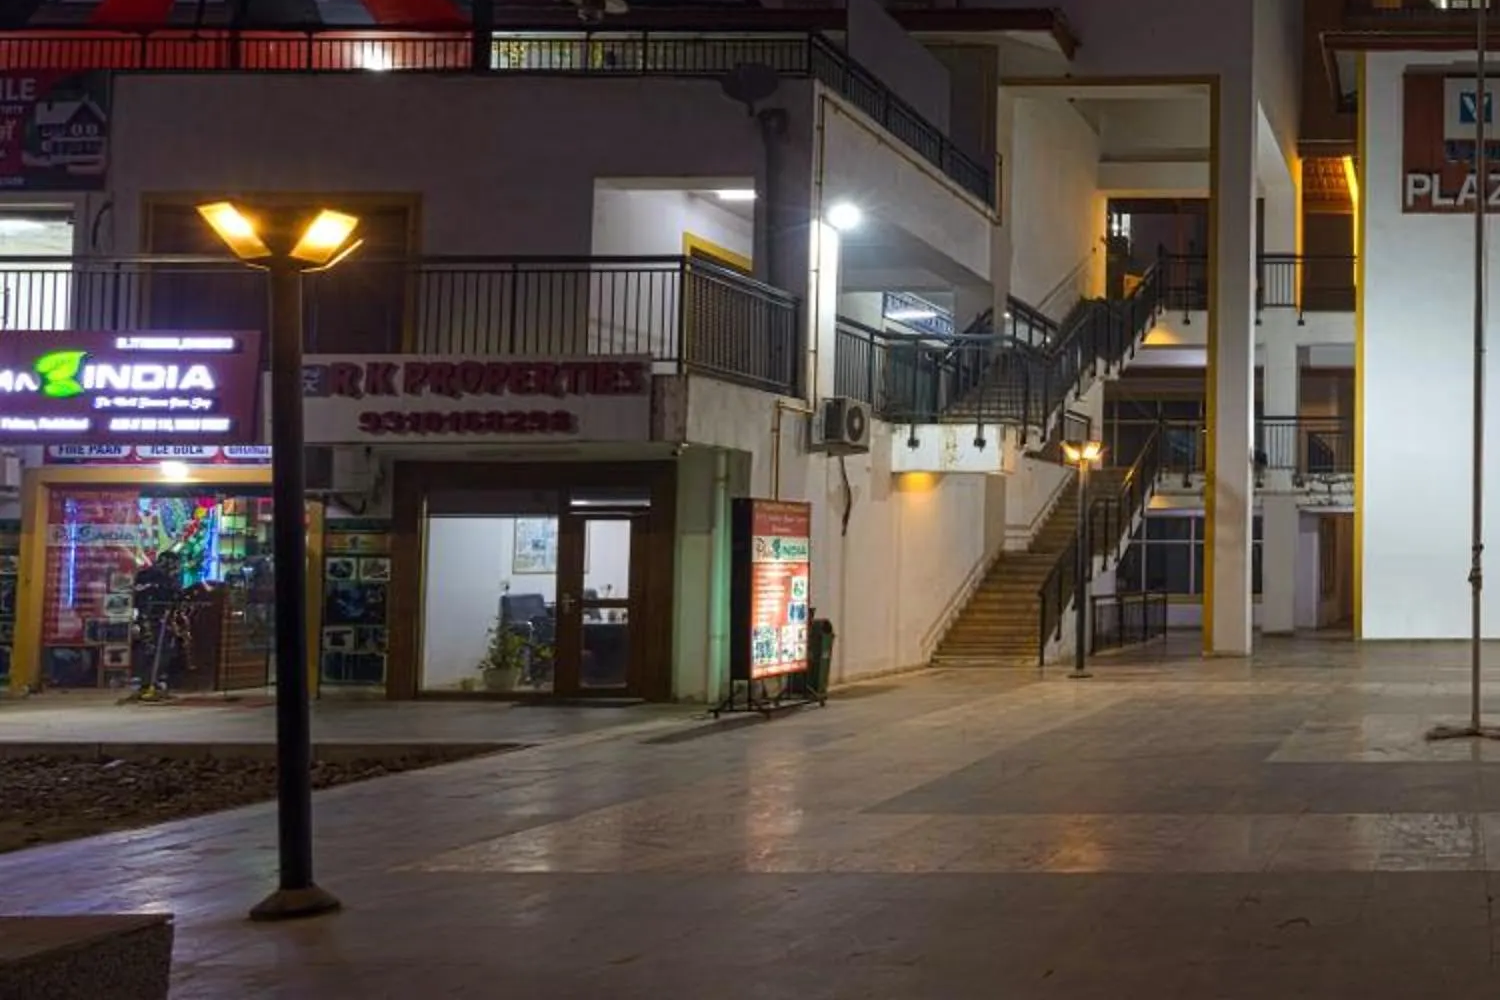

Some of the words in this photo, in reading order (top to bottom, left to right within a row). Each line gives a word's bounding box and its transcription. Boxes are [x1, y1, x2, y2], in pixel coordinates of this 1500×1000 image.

[0, 78, 37, 101] LE
[83, 365, 215, 391] INDIA
[403, 361, 645, 399] PROPERTIES
